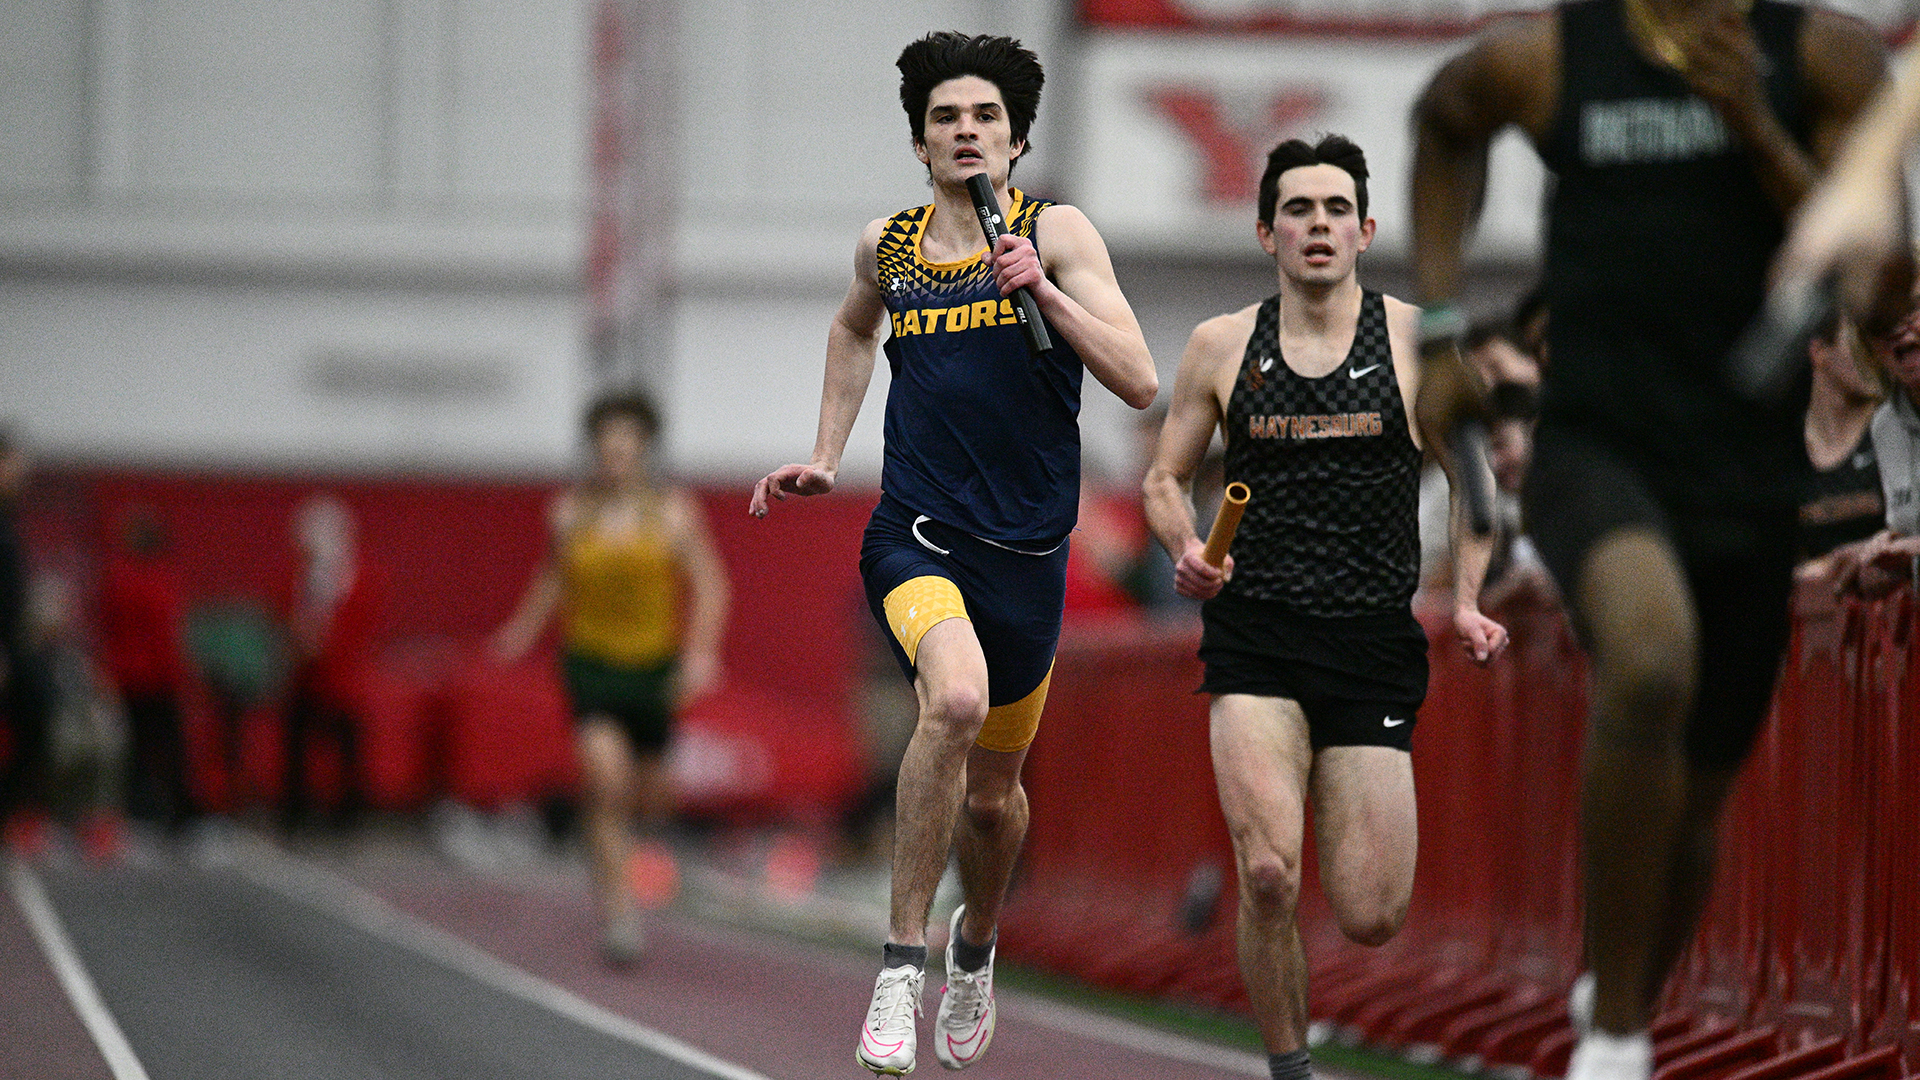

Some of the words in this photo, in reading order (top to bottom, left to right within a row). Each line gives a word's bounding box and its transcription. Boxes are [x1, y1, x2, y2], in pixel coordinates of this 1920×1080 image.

[892, 298, 1017, 338] GATORS
[1017, 306, 1027, 324] GILL
[1250, 412, 1383, 439] WAYNESBURG
